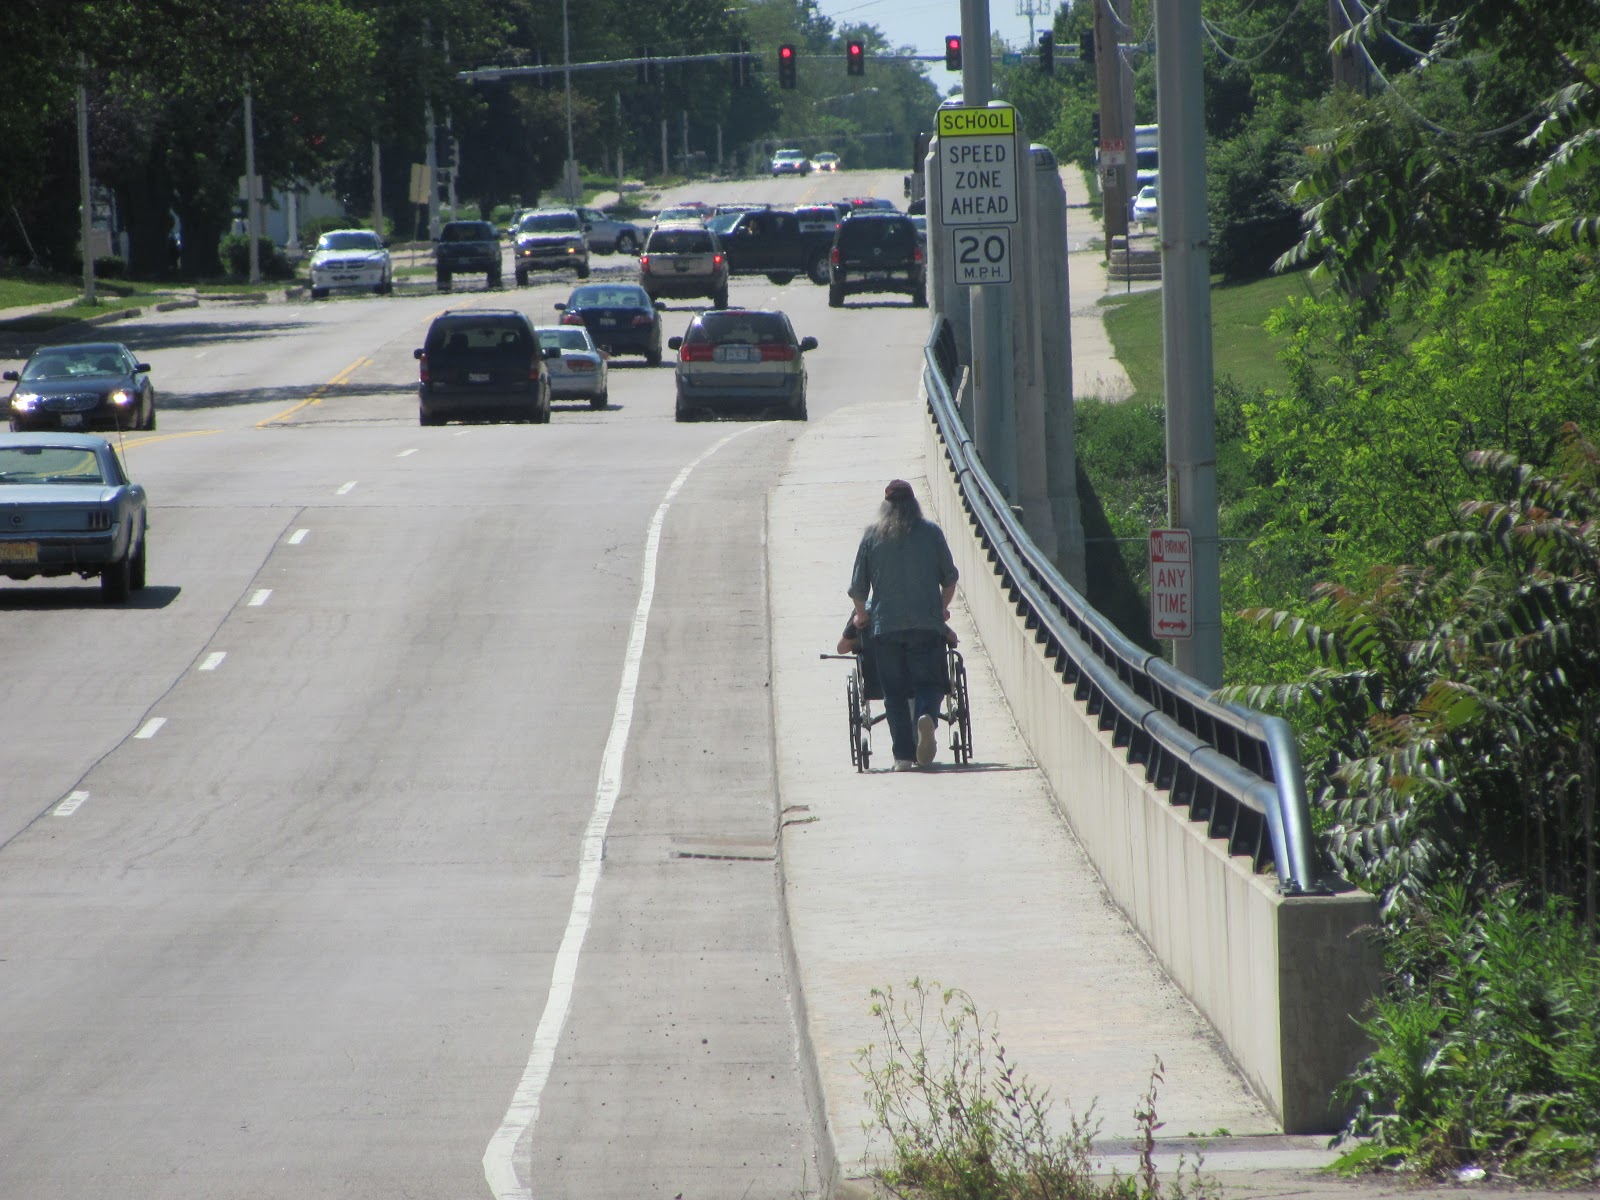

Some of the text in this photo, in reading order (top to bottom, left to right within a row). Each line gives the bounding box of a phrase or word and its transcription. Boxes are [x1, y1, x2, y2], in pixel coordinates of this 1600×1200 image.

[943, 113, 1009, 130] SCHOOL
[949, 145, 1006, 164] SPEED
[956, 170, 1002, 189] ZONE
[951, 196, 1009, 215] AHEAD
[959, 235, 1005, 264] 20
[1151, 536, 1187, 557] NO PARKING
[1157, 568, 1186, 588] ANY
[1157, 593, 1187, 614] TIME
